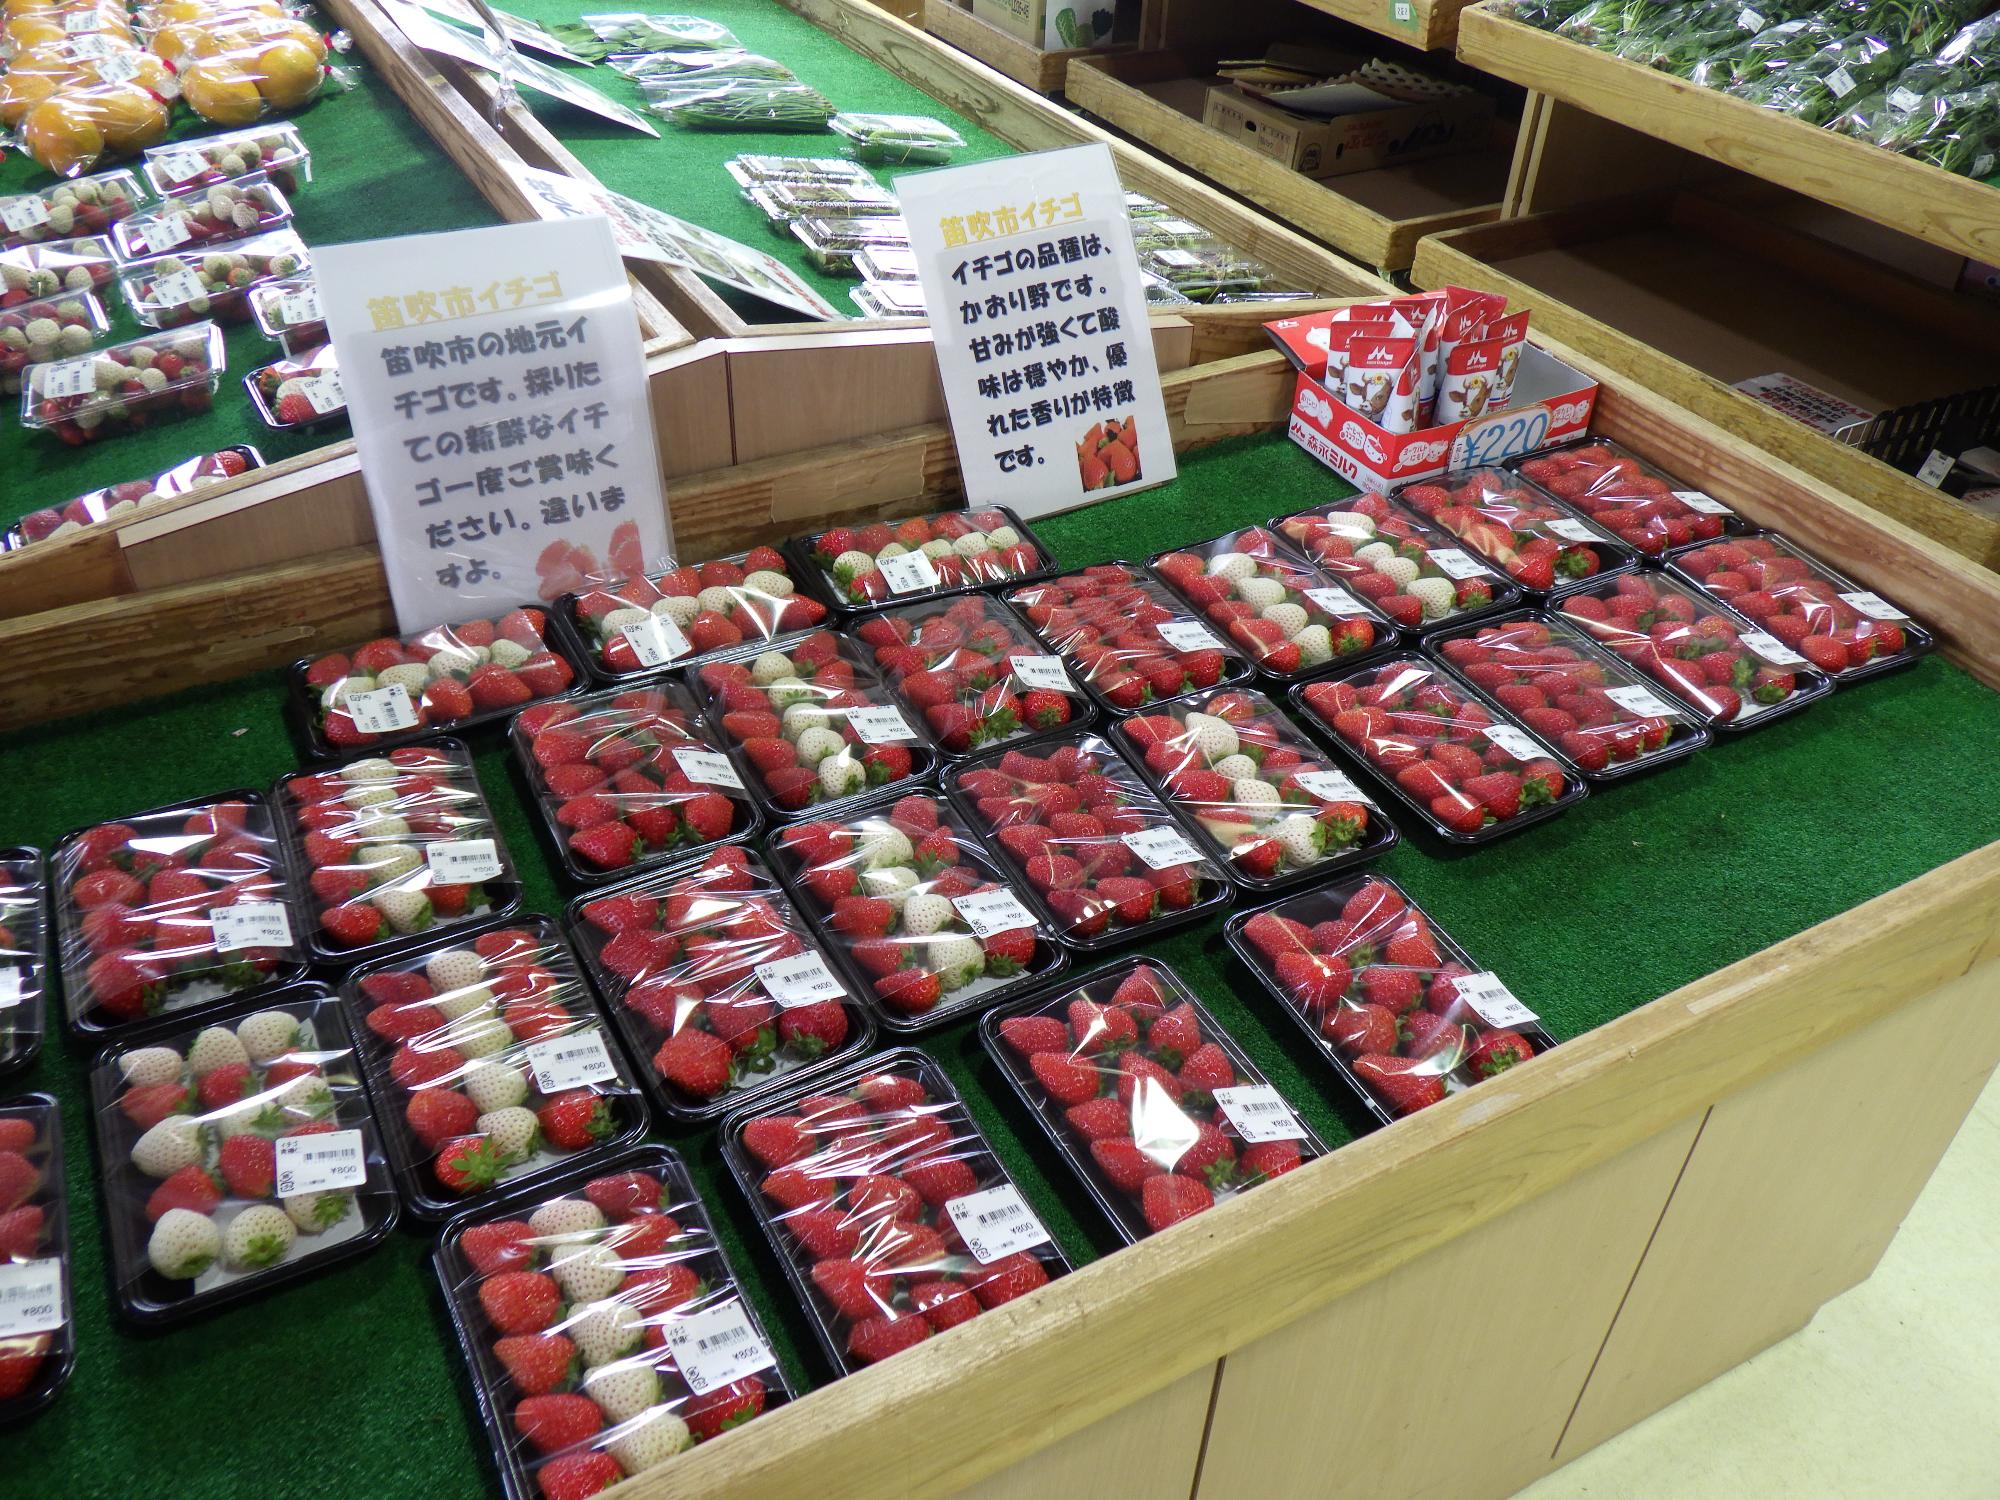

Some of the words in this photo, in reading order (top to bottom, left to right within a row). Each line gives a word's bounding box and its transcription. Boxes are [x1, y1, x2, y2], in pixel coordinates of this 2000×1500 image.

[938, 192, 1084, 248] 笛吹市イチゴ
[951, 233, 1112, 287] イチゴの品種は、
[366, 271, 564, 331] 笛吹市イチゴ
[959, 274, 1107, 325] かおり野です。
[380, 316, 589, 377] 笛吹市の地元イ
[968, 306, 1122, 363] 甘みが強くて酸
[393, 361, 602, 420] チゴです。採りた
[977, 342, 1128, 400] 味は穏やか、優
[403, 402, 610, 463] ての新鮮なイチ
[986, 379, 1137, 438] れた香りが特徴
[994, 444, 1045, 474] です。
[1306, 432, 1358, 480] 森永ミルク
[1461, 413, 1548, 468] ¥220
[425, 485, 627, 549] ださい。違いま
[435, 559, 502, 589] すよ。
